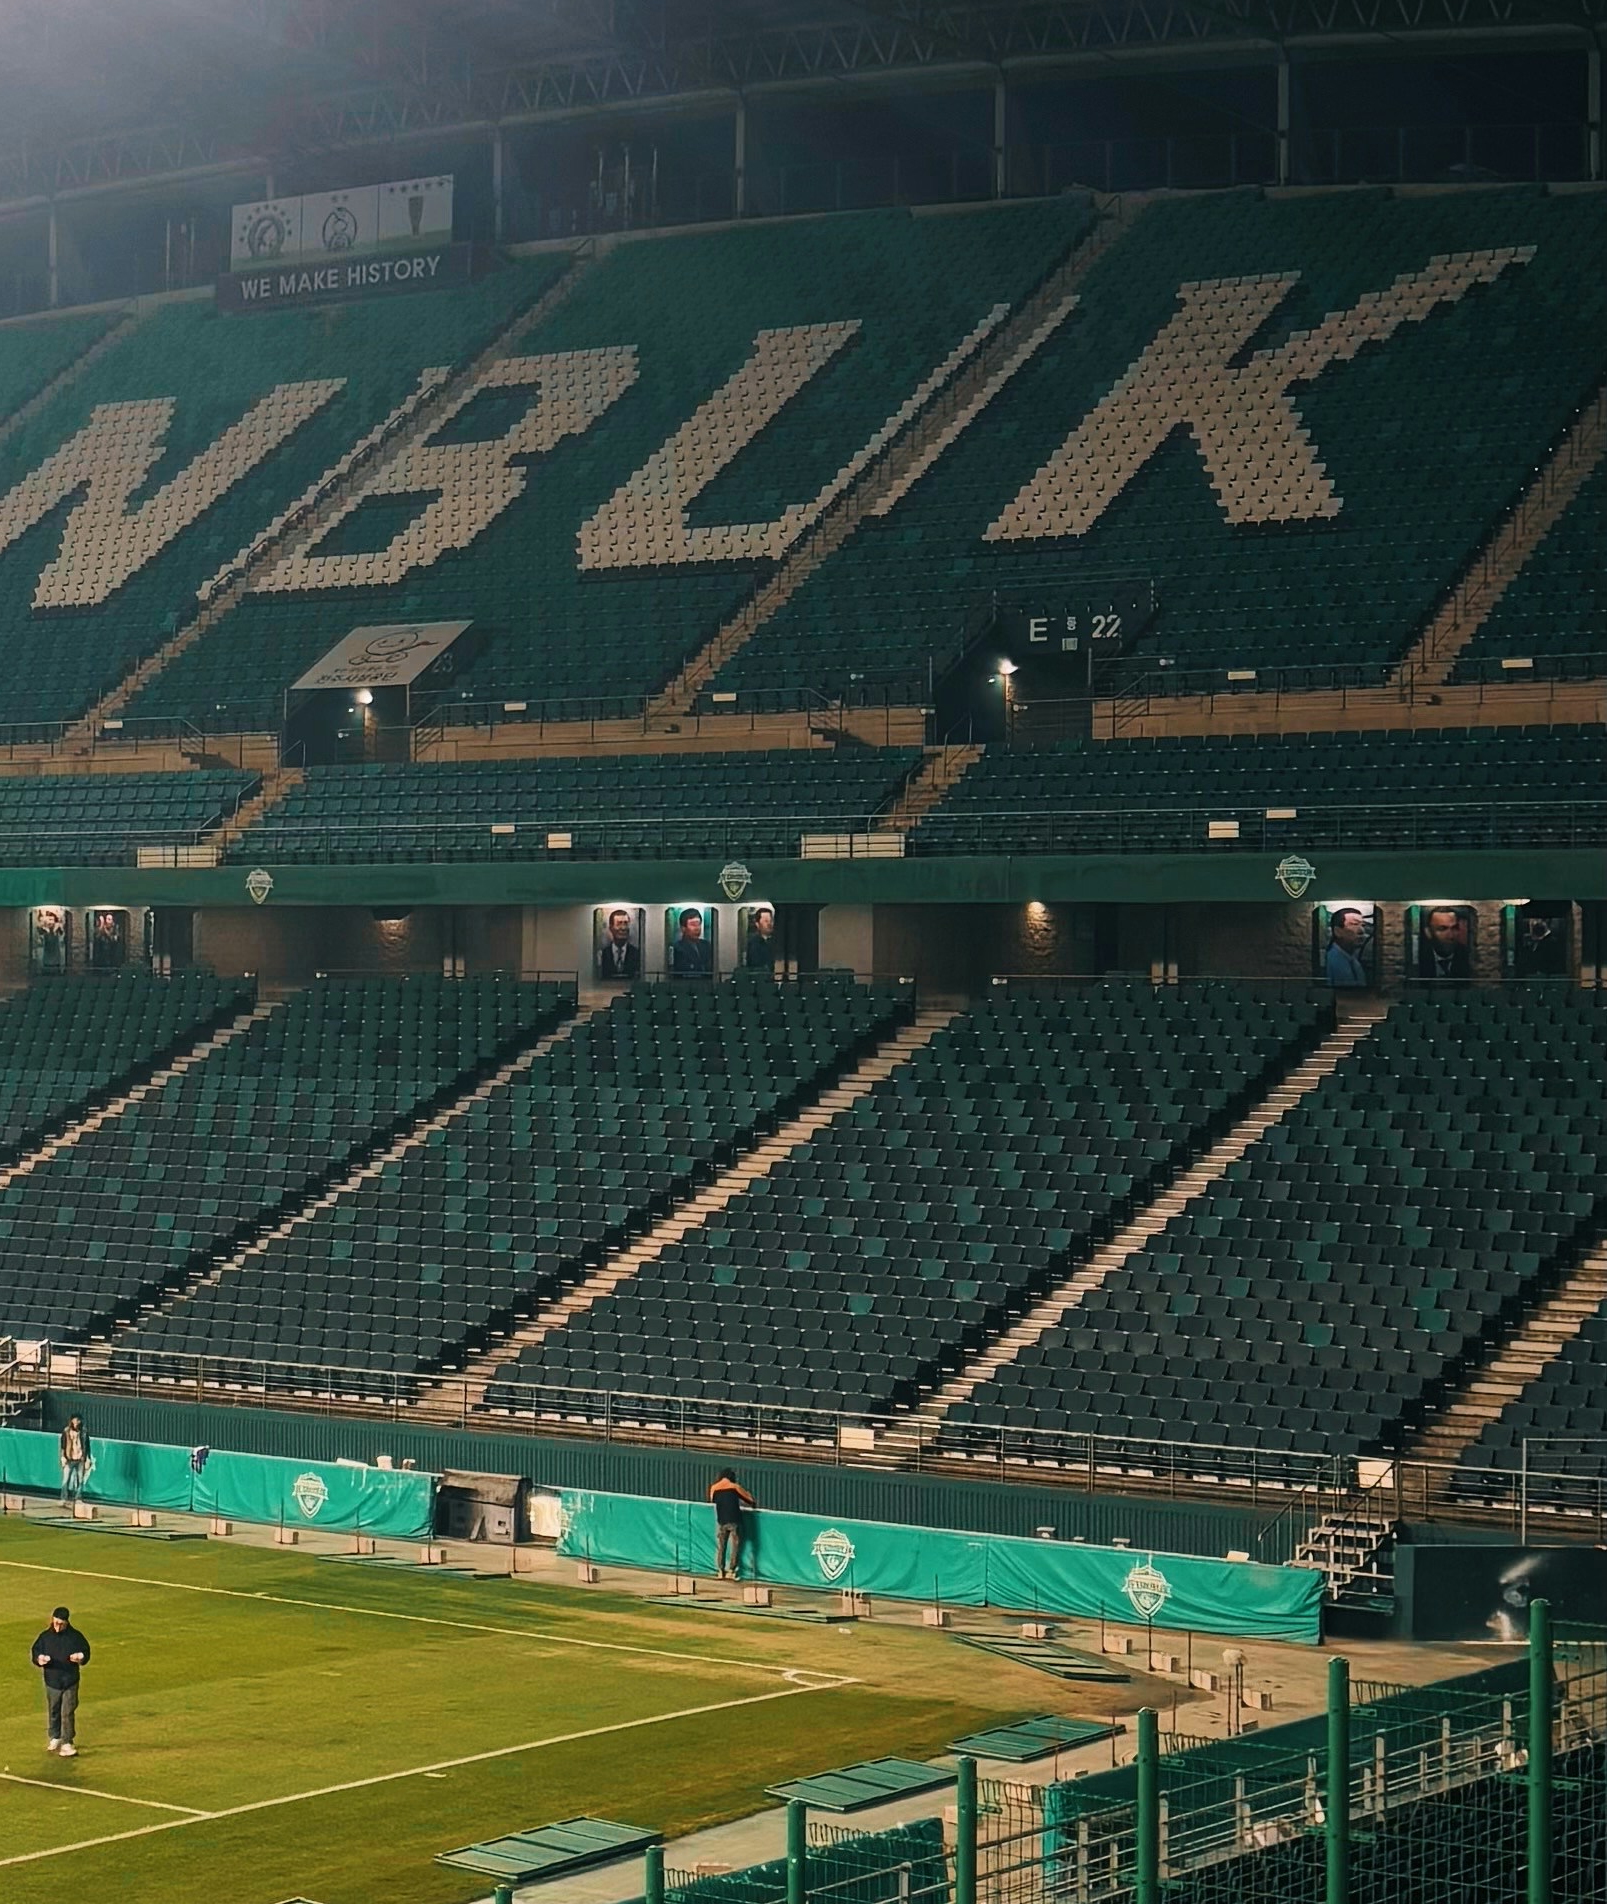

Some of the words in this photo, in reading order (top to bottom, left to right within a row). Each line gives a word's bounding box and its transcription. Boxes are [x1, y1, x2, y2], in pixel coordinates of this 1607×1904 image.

[241, 278, 270, 299] WE
[279, 269, 339, 295] MAKE
[348, 256, 441, 286] HISTORY
[1030, 618, 1048, 642] E
[1092, 614, 1122, 638] 22
